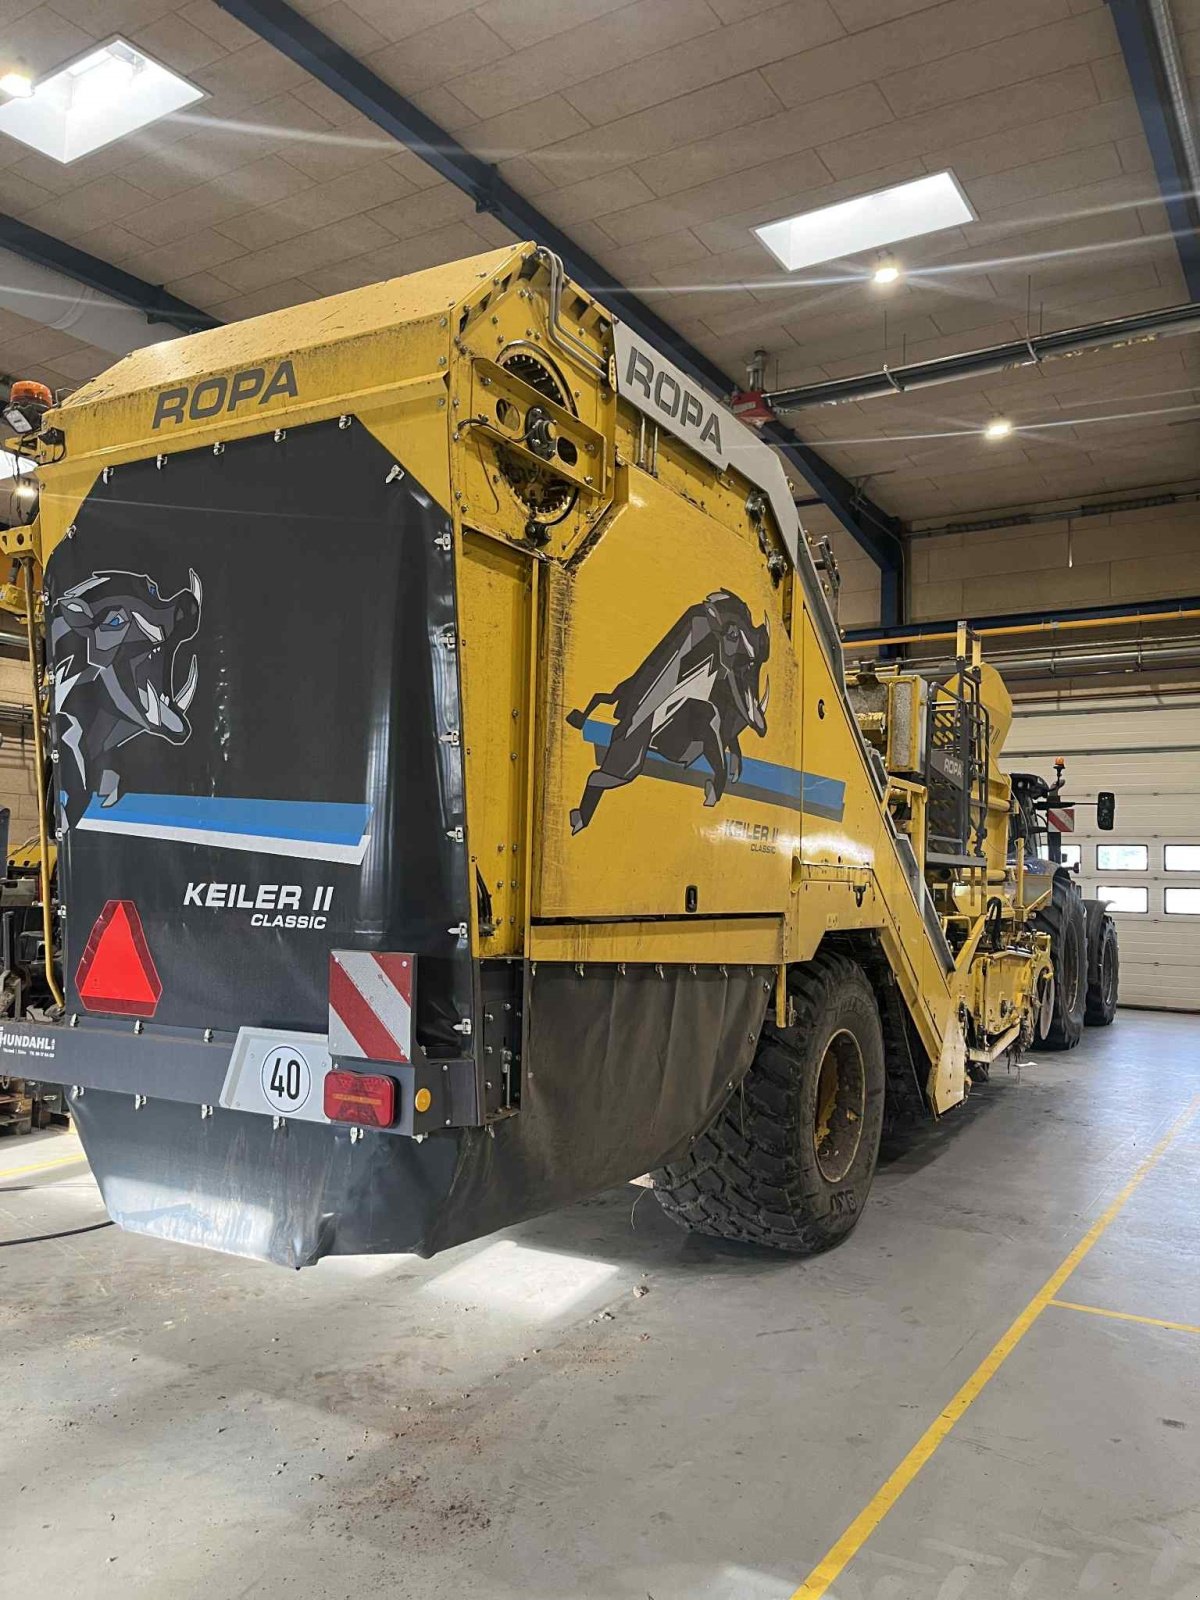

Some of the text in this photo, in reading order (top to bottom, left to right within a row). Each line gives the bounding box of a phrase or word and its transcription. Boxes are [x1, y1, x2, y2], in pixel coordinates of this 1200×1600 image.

[152, 360, 298, 429] ROPA
[626, 346, 721, 455] ROPA
[725, 819, 769, 841] KEILER
[750, 843, 776, 854] CLASSIC
[183, 882, 334, 911] KEILER II
[250, 914, 327, 929] CLASSIC
[270, 1058, 300, 1100] 40
